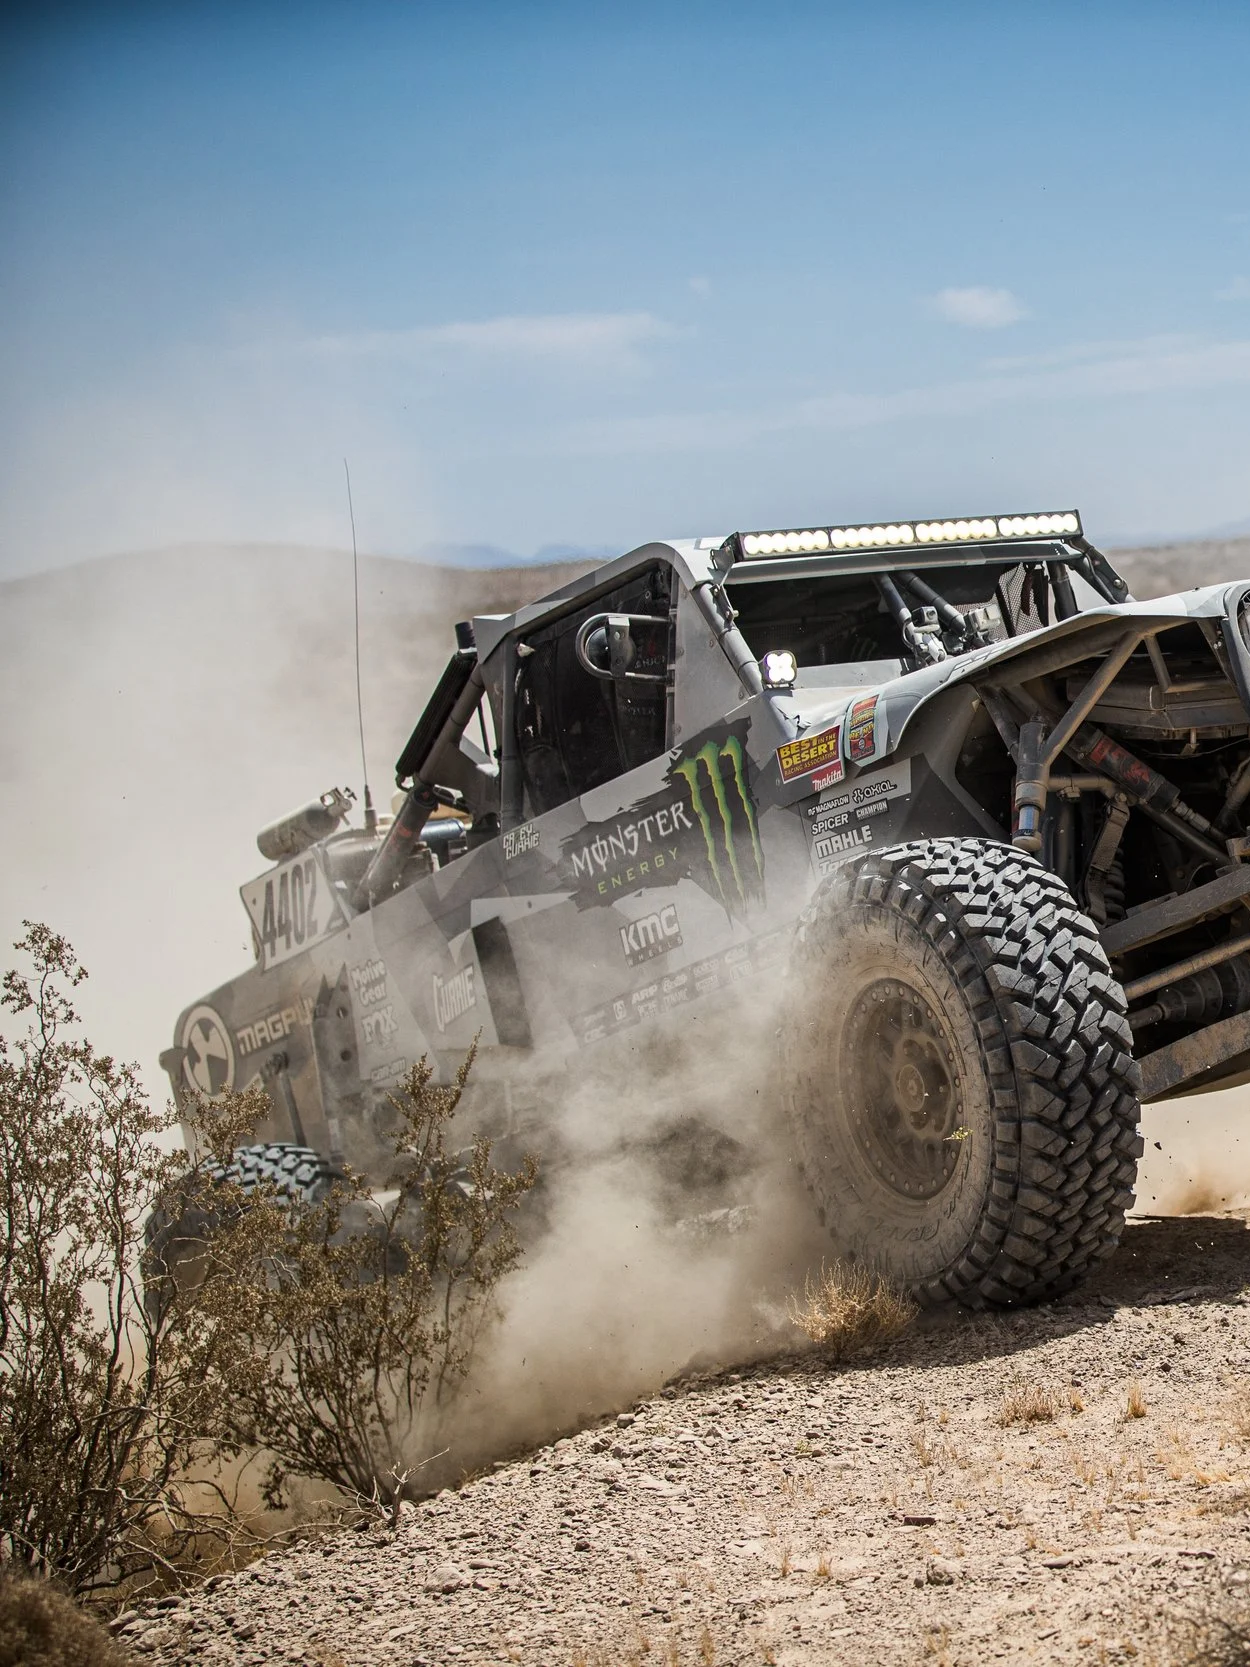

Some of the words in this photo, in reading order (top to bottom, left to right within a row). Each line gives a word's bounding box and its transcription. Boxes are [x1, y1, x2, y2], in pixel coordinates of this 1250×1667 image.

[779, 735, 819, 759] BEST
[782, 741, 836, 770] DESERT
[812, 812, 849, 835] SPICER
[856, 800, 888, 818] CHAMPION
[570, 801, 693, 878] MONSTER
[816, 825, 873, 859] MAHLE
[597, 847, 679, 895] ENERGY
[261, 858, 319, 959] 4402
[627, 935, 684, 966] WHEELS
[350, 959, 387, 990] Motive
[360, 982, 387, 1007] Gear
[433, 964, 476, 1033] CURRIE
[361, 1004, 399, 1045] FOX
